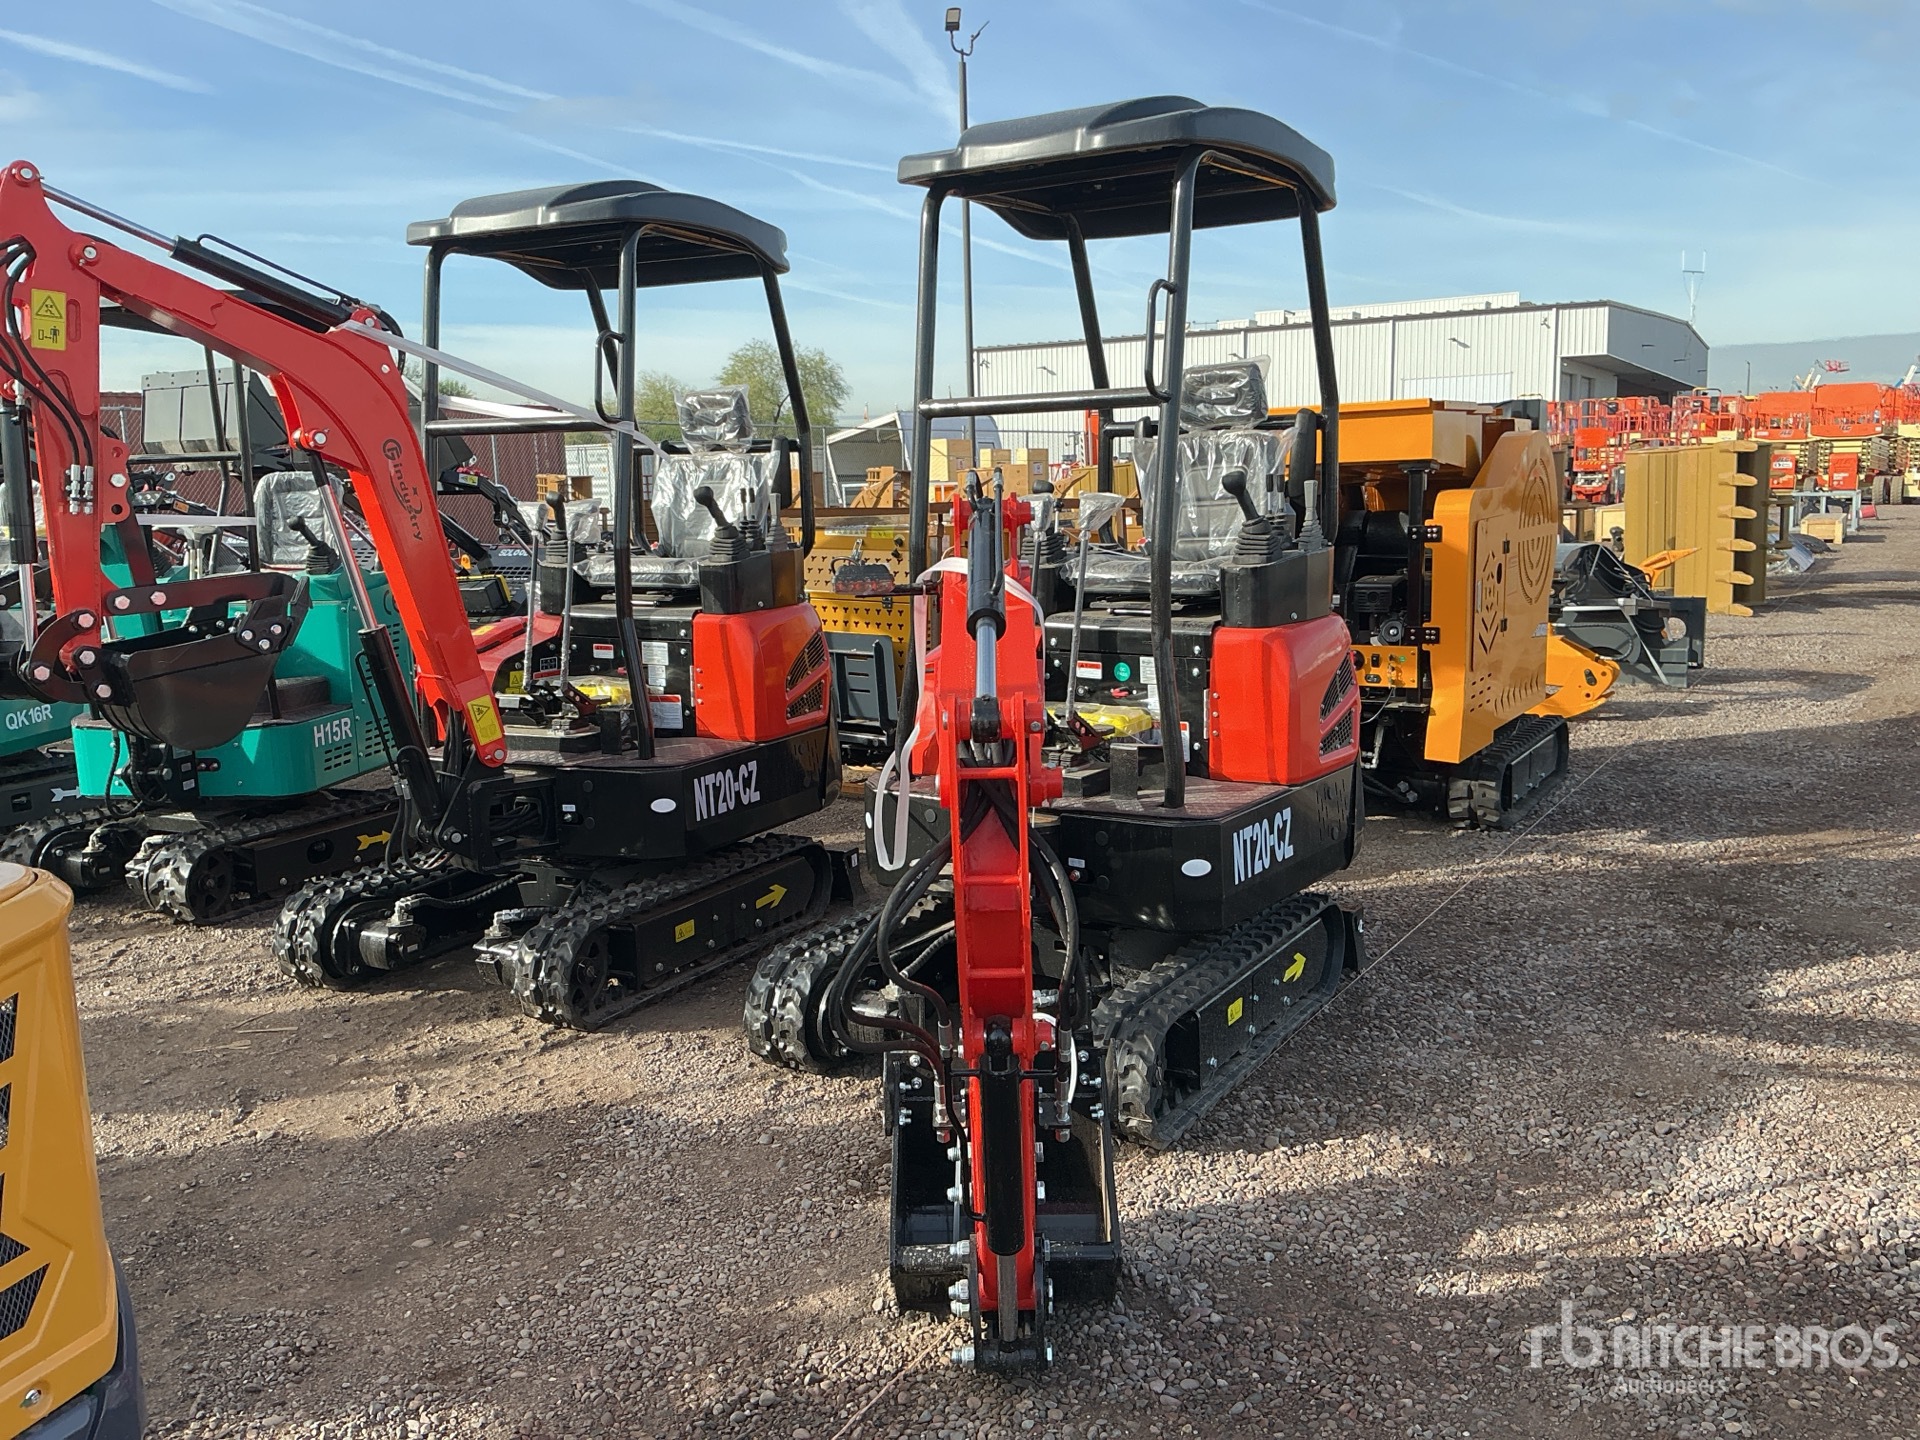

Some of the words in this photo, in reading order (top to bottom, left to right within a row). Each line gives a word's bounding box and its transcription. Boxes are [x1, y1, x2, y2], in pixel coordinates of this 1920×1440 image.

[5, 704, 53, 730] QK16R
[313, 717, 353, 748] H15R
[693, 760, 760, 822] NT20-CZ
[1233, 807, 1294, 885] NT20-CZ
